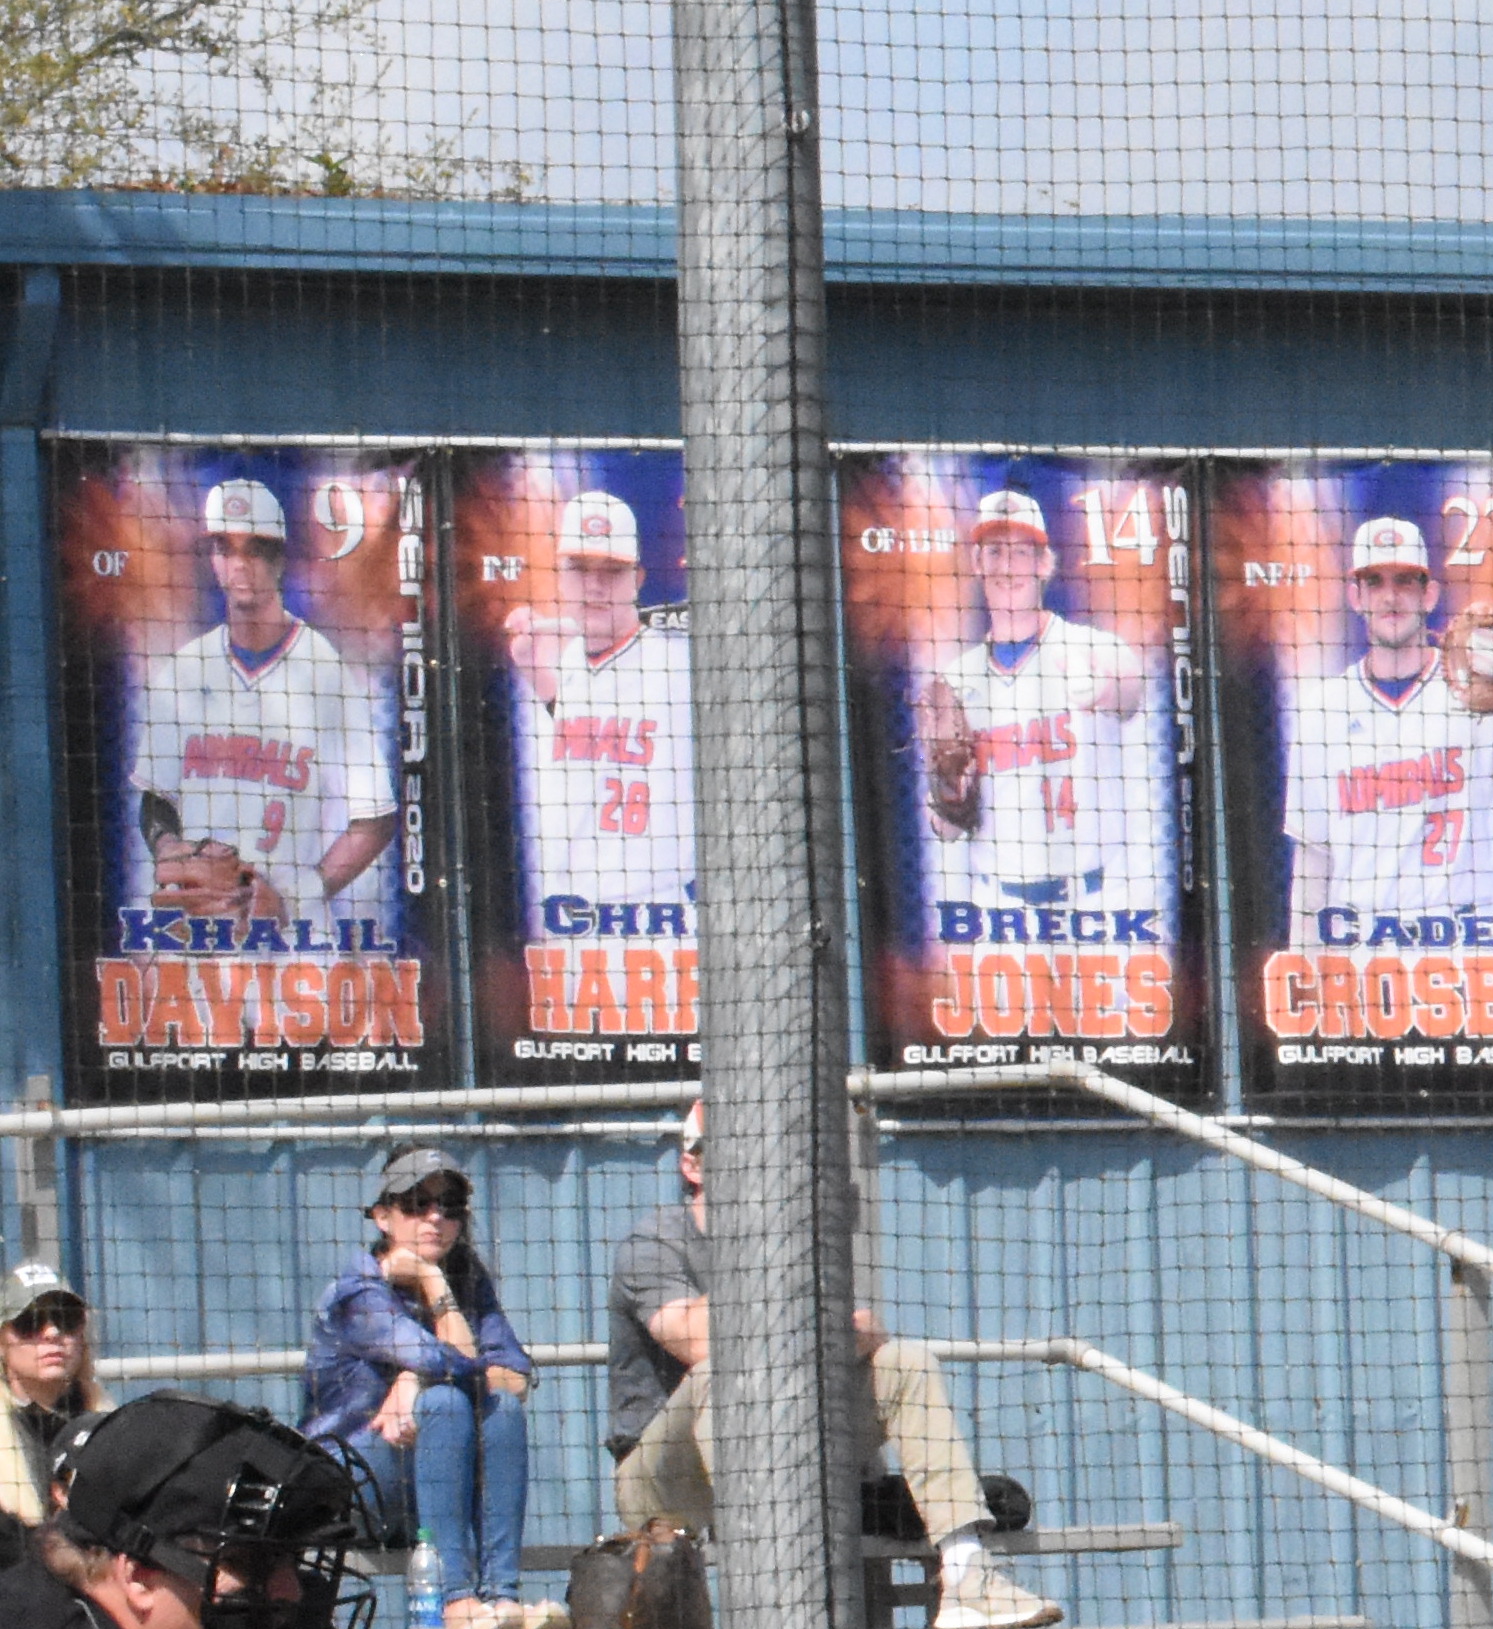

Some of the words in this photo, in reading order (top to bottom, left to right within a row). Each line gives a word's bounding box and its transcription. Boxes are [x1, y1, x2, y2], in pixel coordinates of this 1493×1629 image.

[314, 481, 366, 562] 9
[1072, 485, 1160, 567] 14
[92, 549, 129, 578] OF
[255, 800, 286, 853] 9
[599, 776, 651, 835] 28
[1040, 775, 1078, 834] 14
[1422, 809, 1465, 867] 27
[117, 906, 398, 954] KHALIL
[935, 900, 1162, 943] BRECK
[96, 957, 425, 1047] DAVISON
[931, 951, 1174, 1038] JONES
[238, 1053, 289, 1071] HIGH
[626, 1042, 677, 1062] HIGH
[1394, 1047, 1445, 1066] HIGH
